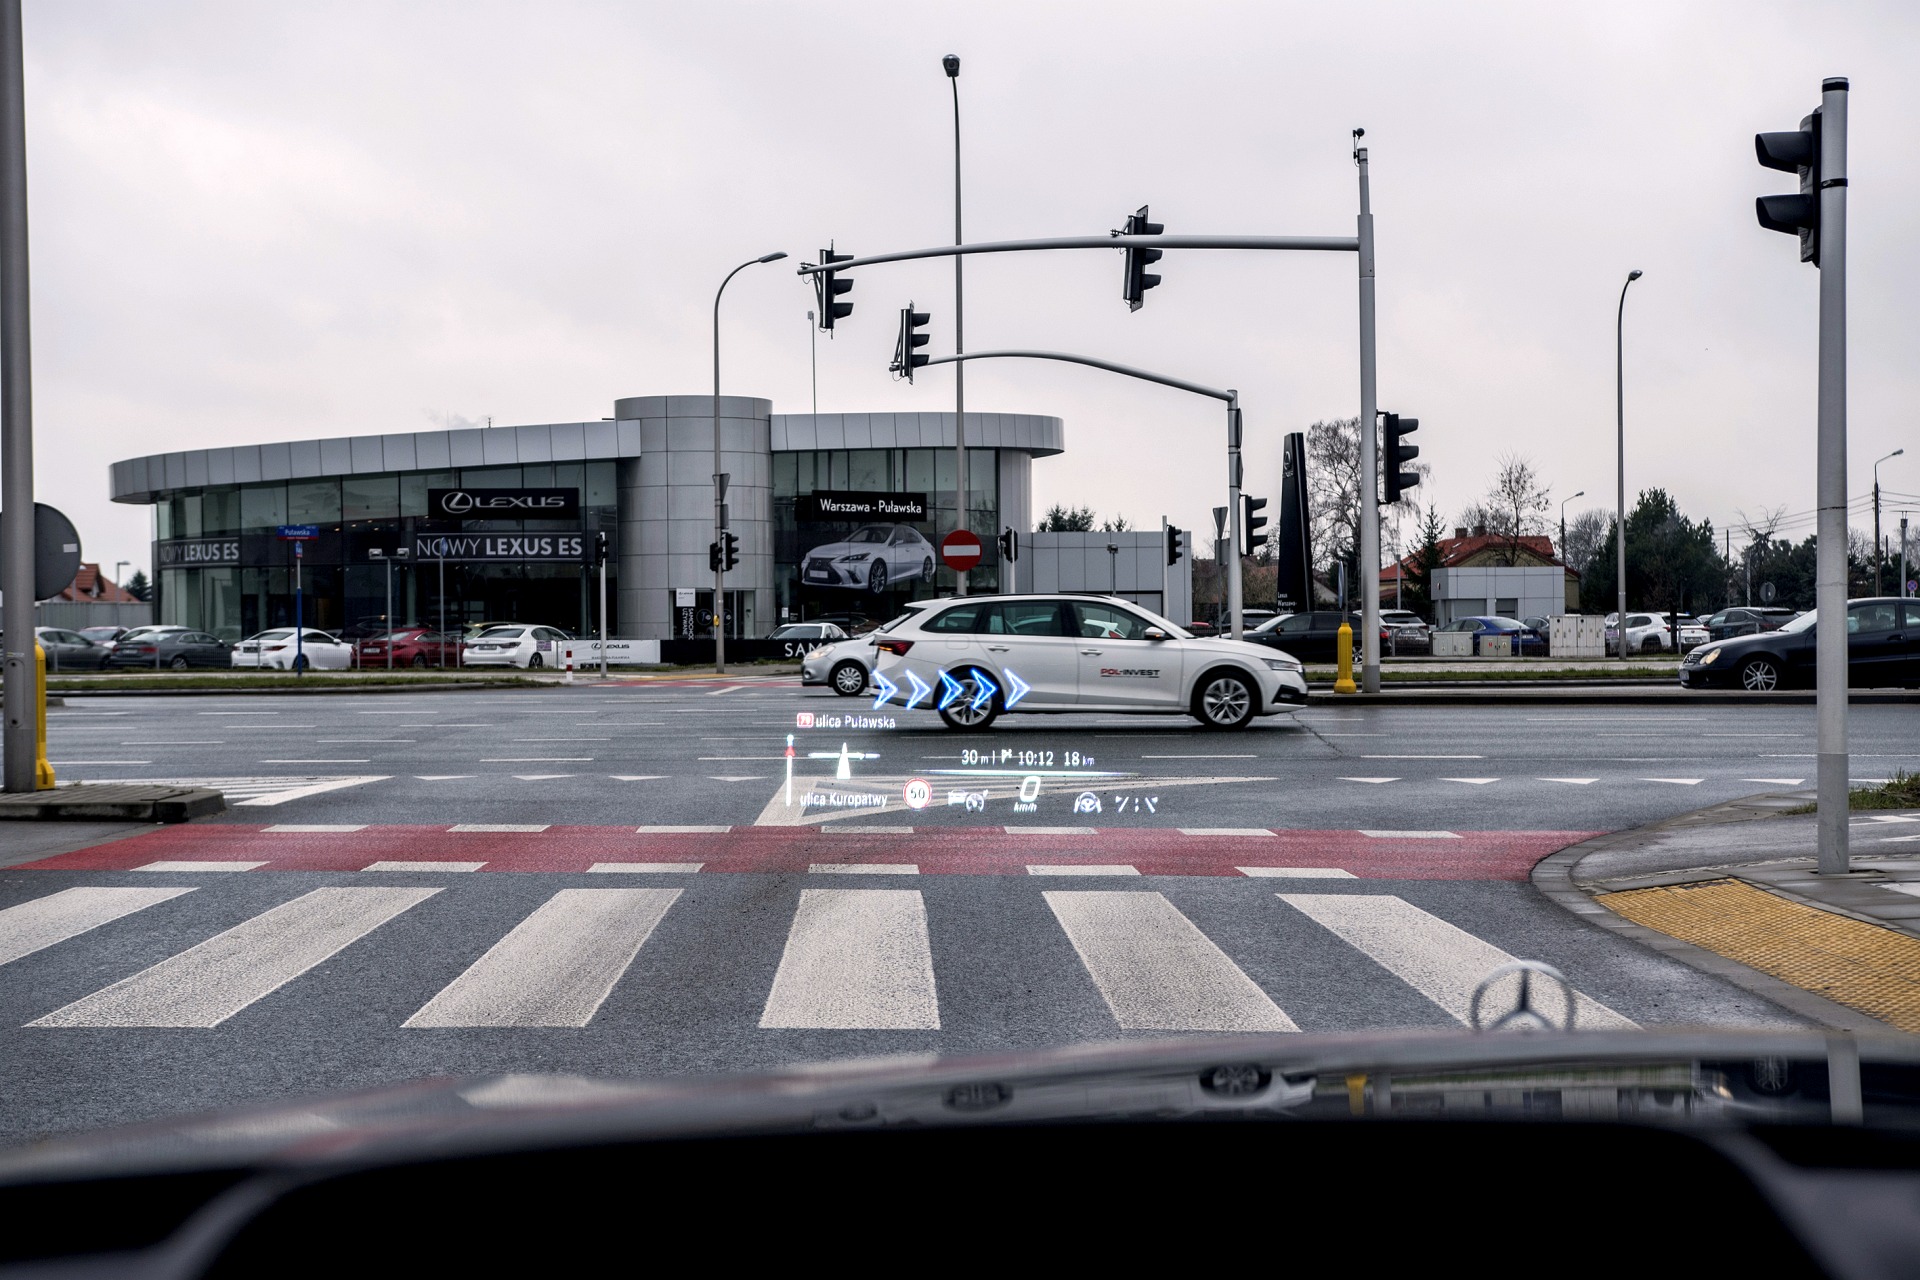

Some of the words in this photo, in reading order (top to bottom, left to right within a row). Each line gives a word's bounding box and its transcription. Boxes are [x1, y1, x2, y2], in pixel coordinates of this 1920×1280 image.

[475, 496, 565, 508] LEXUS
[820, 499, 870, 512] Warszawa
[878, 500, 922, 514] Puławska
[184, 544, 220, 561] LEXUS
[223, 543, 239, 560] ES
[486, 538, 552, 555] LEXUS
[558, 537, 582, 555] ES
[1101, 668, 1160, 676] POL-INVEST
[815, 714, 842, 729] ulica
[844, 715, 896, 729] Puławska
[961, 749, 978, 766] 30
[1018, 750, 1054, 767] 10:12
[1064, 751, 1080, 767] 18
[910, 787, 926, 800] 50
[1020, 775, 1041, 802] 0
[800, 792, 826, 807] ulica
[829, 792, 888, 809] Kuropatwy
[1013, 801, 1038, 813] km/h
